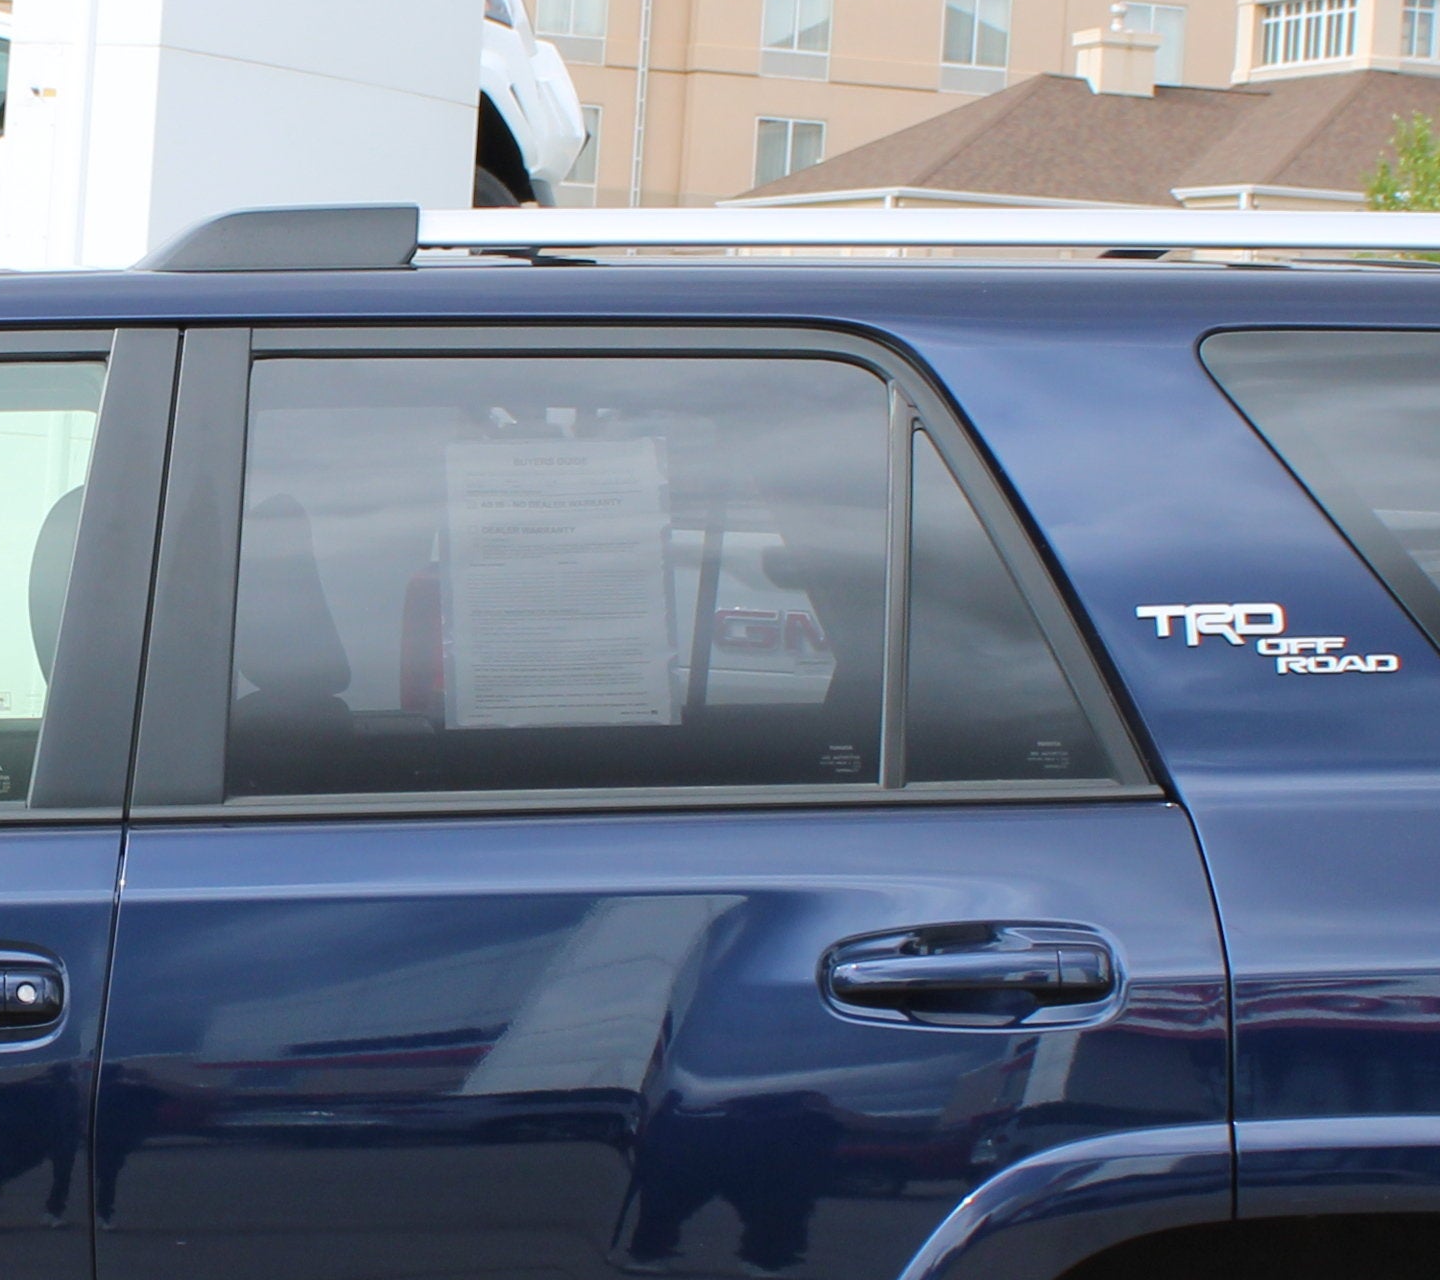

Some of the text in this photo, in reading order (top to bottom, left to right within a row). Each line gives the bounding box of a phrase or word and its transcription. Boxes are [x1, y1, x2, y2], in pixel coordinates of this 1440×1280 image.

[1135, 603, 1285, 646] TRD
[1256, 637, 1346, 655] OFF
[1277, 655, 1400, 673] ROAD
